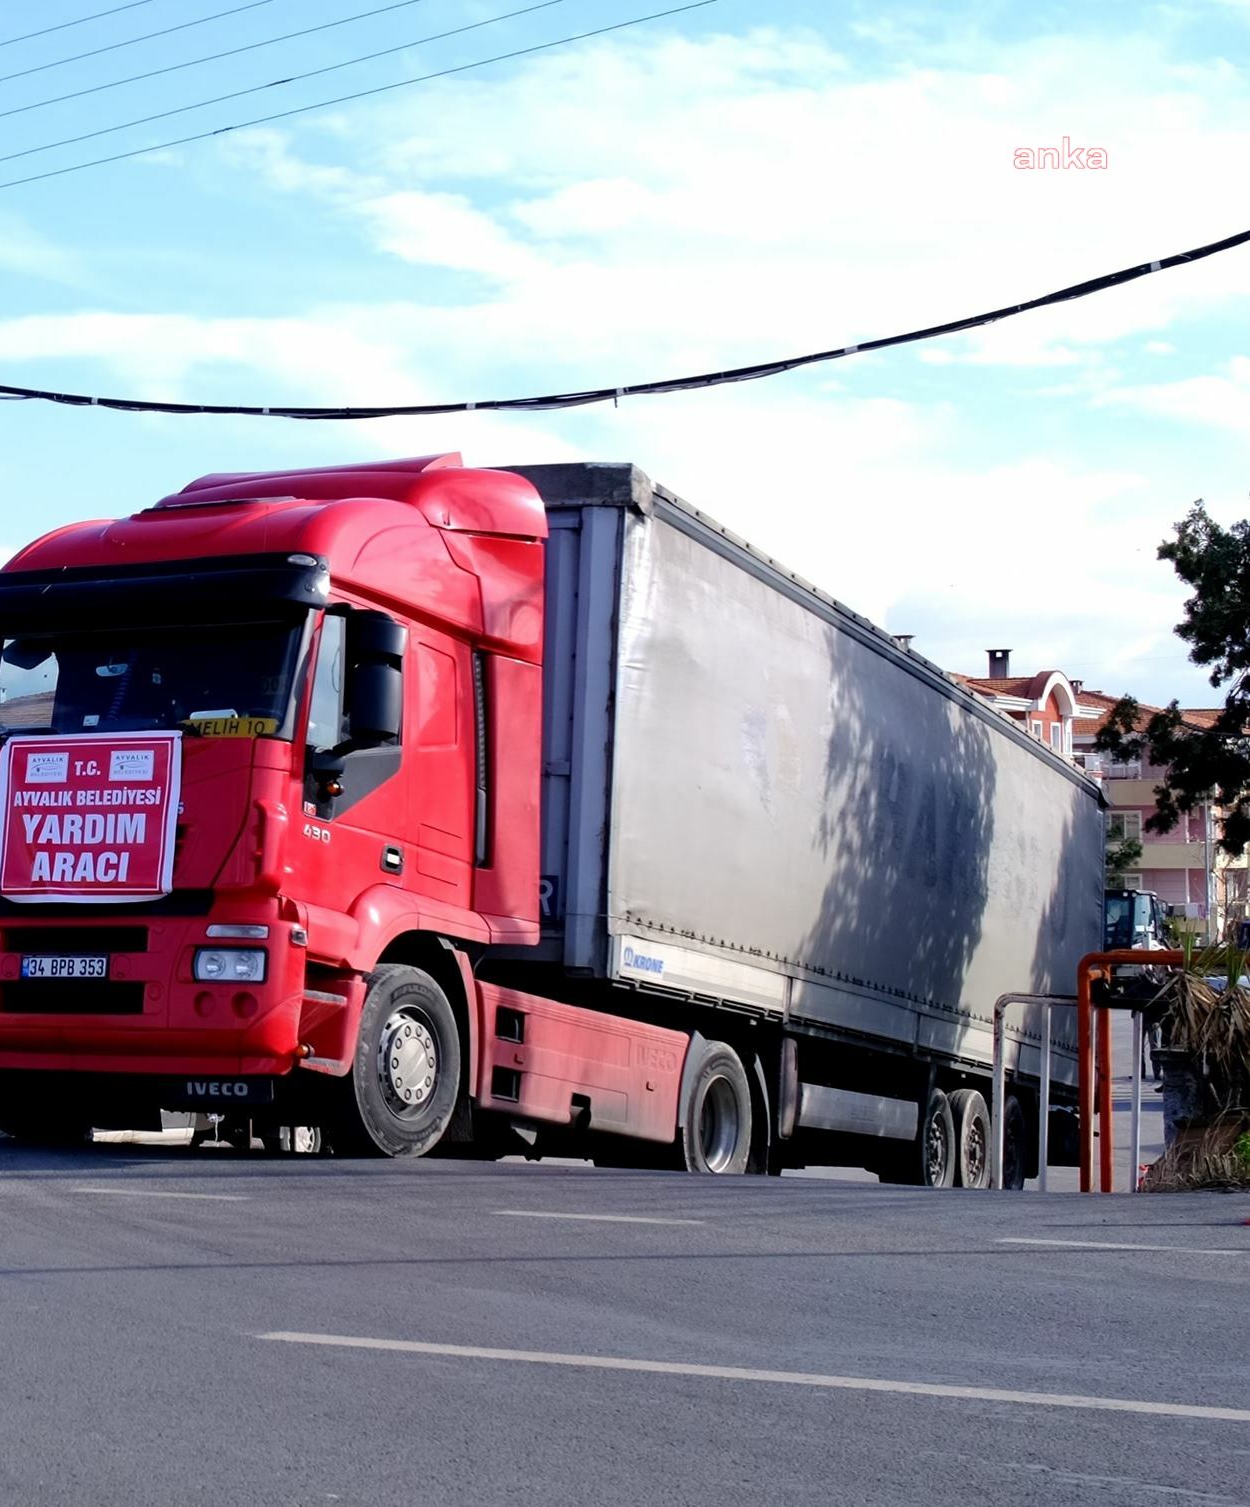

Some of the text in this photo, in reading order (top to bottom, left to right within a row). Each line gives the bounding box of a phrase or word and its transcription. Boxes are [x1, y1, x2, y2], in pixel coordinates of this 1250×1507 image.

[74, 760, 101, 776] T.C.
[13, 786, 162, 807] AYVALIK BELEDİYESİ
[22, 813, 147, 844] YARDIM
[303, 823, 331, 844] 430
[31, 851, 130, 882] ARACI
[30, 959, 105, 975] 34 BPB 353
[633, 954, 664, 973] KRONE
[186, 1081, 249, 1096] IVECO
